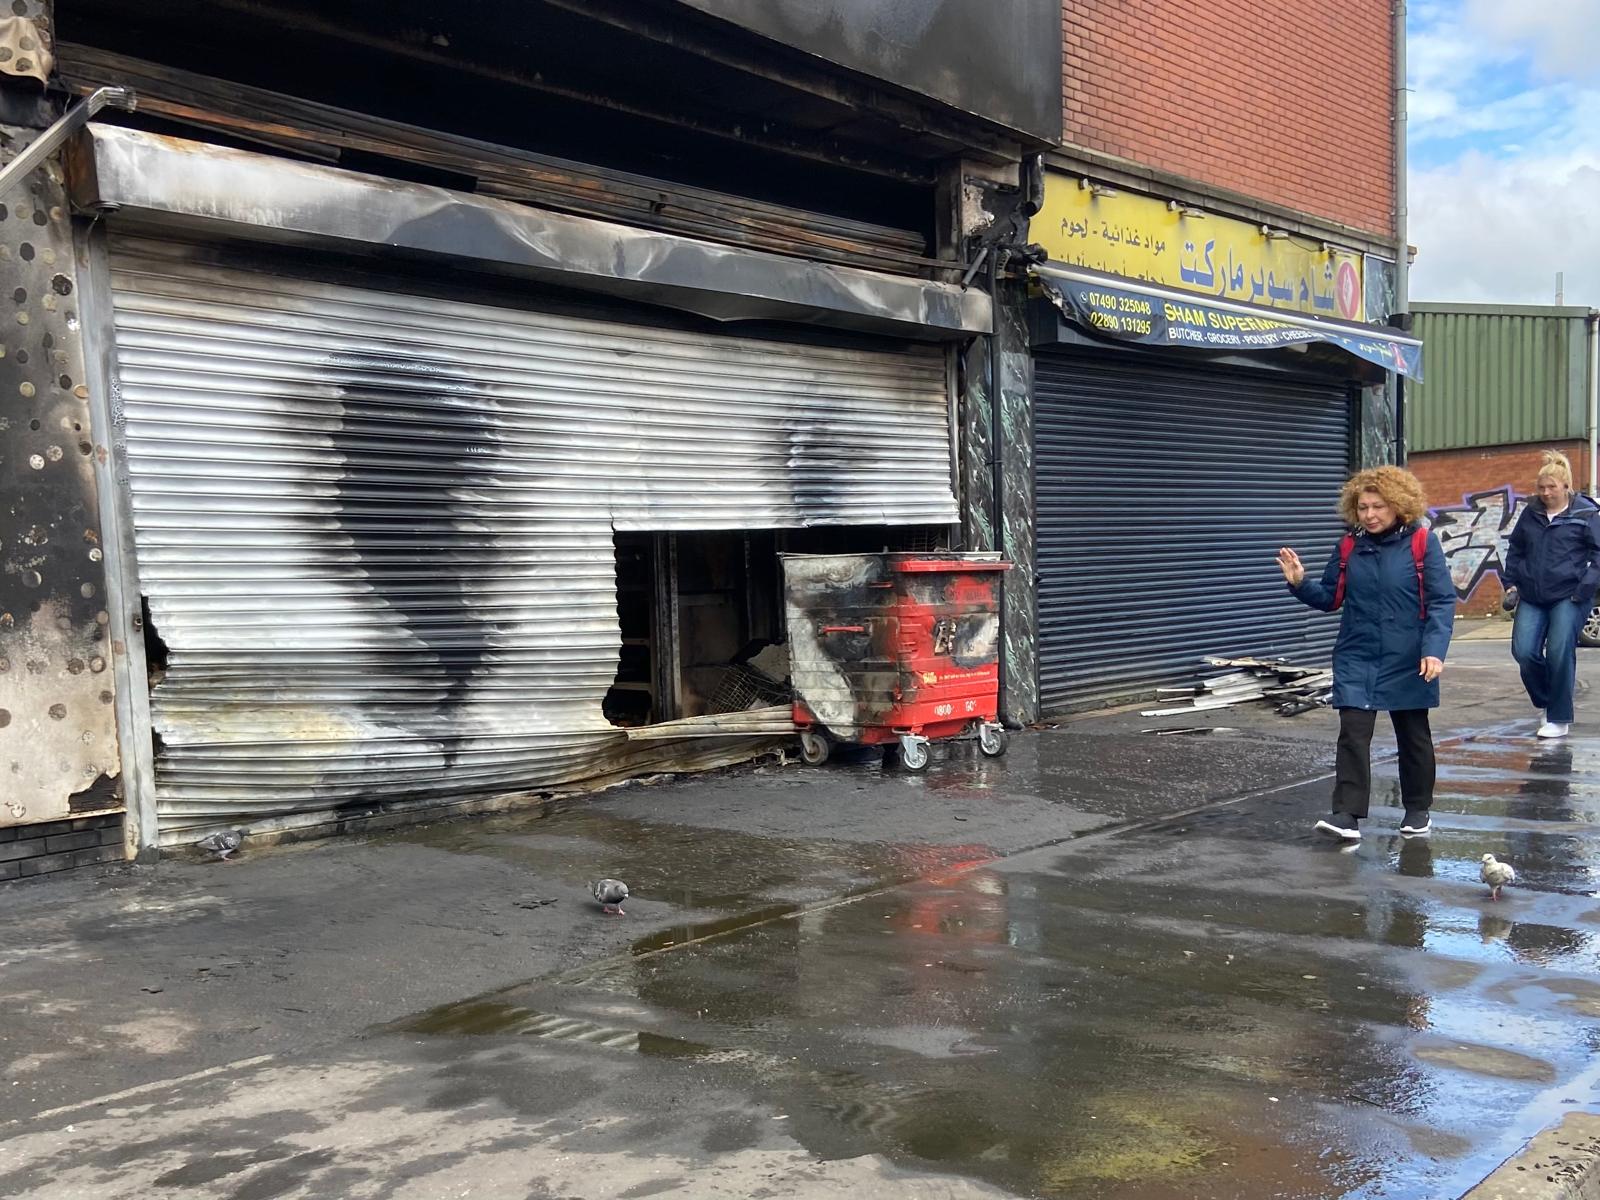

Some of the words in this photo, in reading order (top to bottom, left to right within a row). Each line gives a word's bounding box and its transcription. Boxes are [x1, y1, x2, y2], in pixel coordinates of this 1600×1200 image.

[1060, 216, 1089, 239] لحوم
[1101, 220, 1141, 247] غذائية
[1143, 234, 1166, 256] مواد
[1179, 239, 1244, 297] ماركت
[1300, 262, 1335, 310] شام
[1089, 292, 1117, 311] 07490
[1119, 297, 1152, 316] 325048
[1163, 302, 1208, 328] SHAM
[1120, 316, 1152, 336] 131295
[1168, 326, 1205, 343] BUTCHER
[1206, 331, 1241, 345] GROCERY
[1244, 334, 1281, 345] POULTRY
